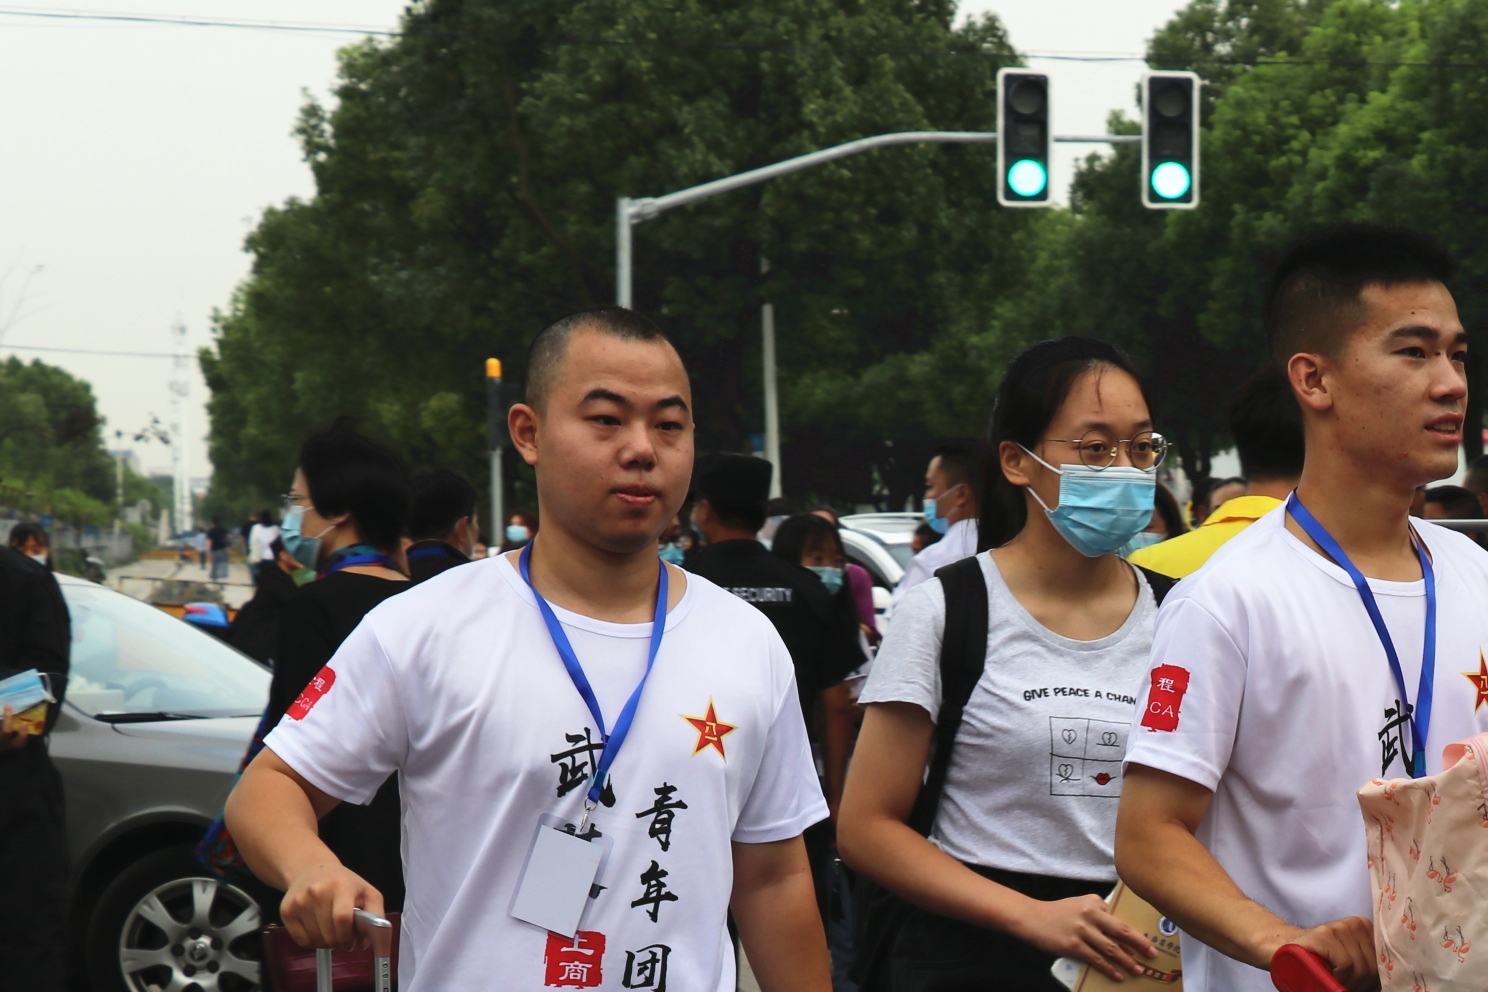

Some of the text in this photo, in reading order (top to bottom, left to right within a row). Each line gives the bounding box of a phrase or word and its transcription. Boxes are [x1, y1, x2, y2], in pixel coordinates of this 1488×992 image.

[732, 587, 792, 602] SECURITY
[1156, 677, 1175, 693] 程
[1023, 687, 1049, 701] GIVE
[1053, 687, 1090, 698] PEACE
[1094, 690, 1103, 699] A
[1149, 701, 1174, 718] CA
